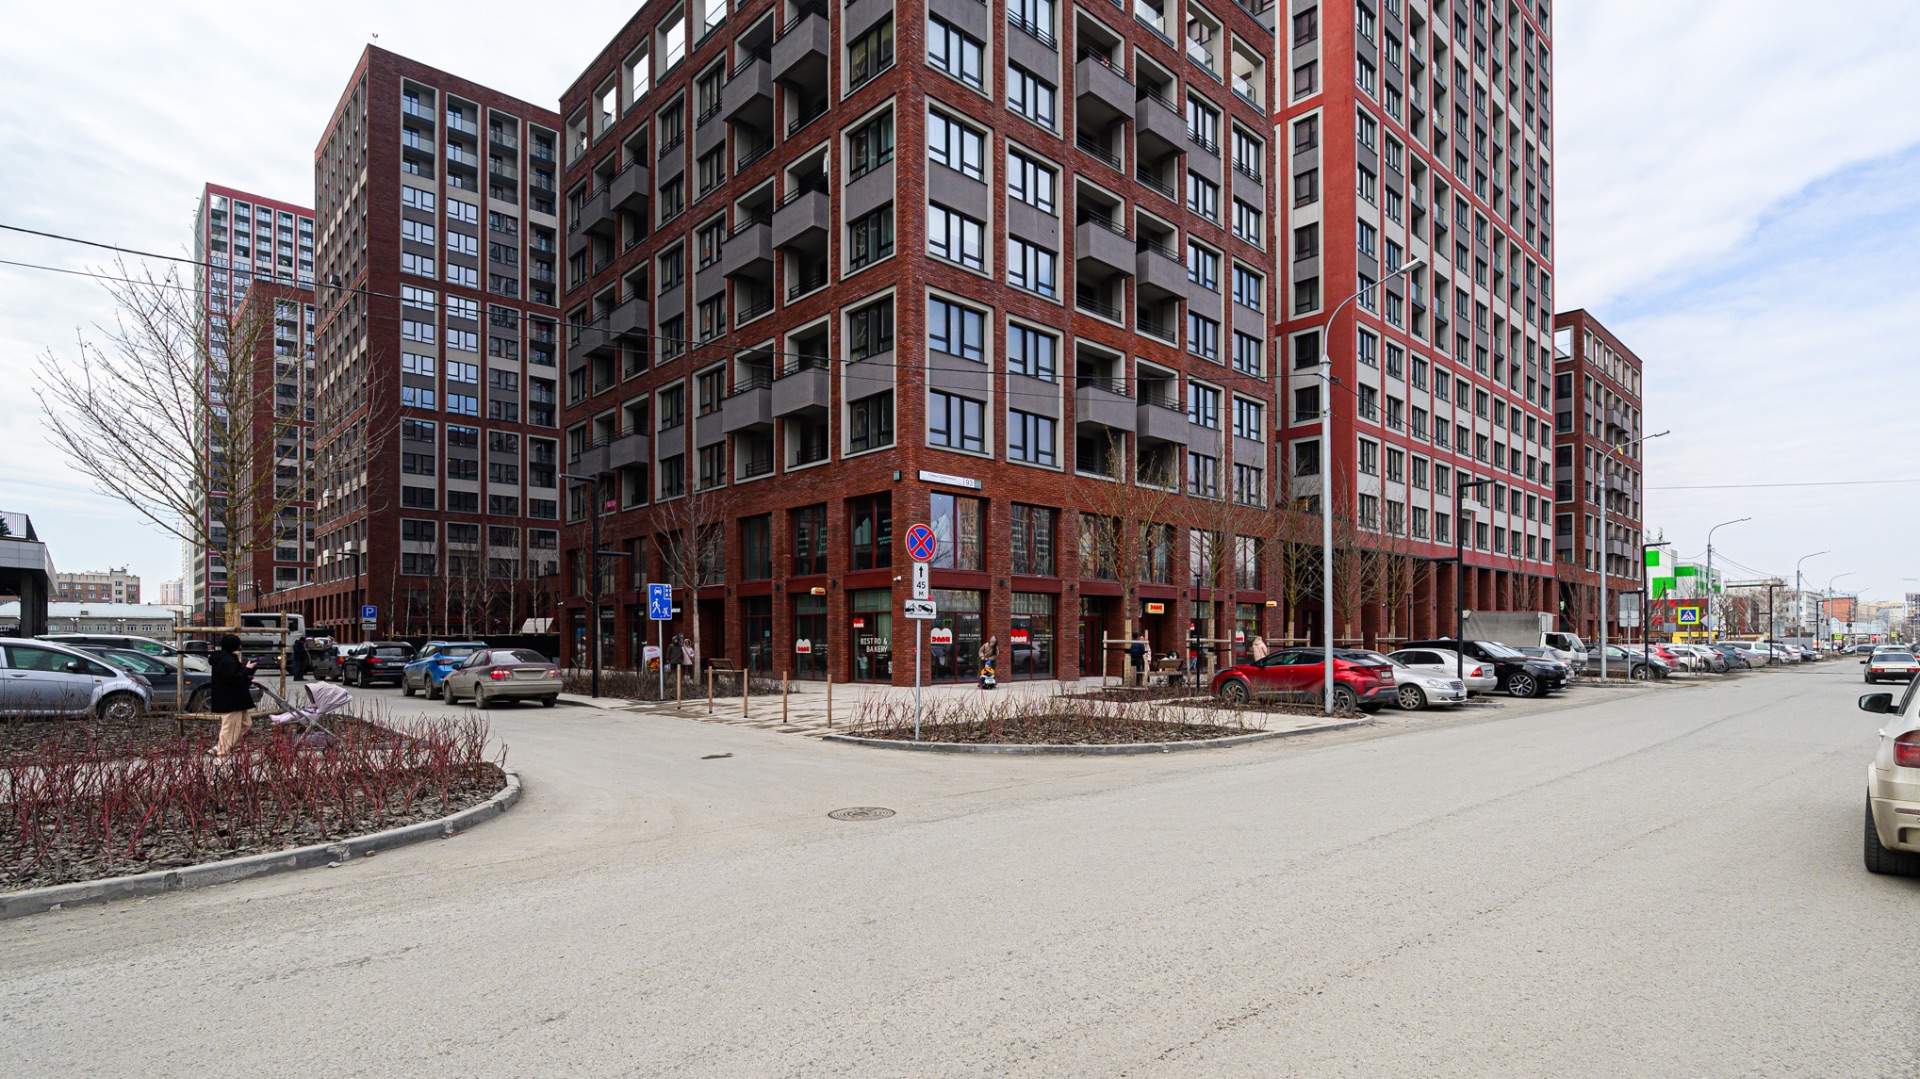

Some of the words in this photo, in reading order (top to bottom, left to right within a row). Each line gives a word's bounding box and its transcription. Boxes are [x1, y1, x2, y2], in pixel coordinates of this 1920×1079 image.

[916, 581, 926, 589] 45
[366, 607, 374, 617] P
[860, 637, 881, 646] BISTRO
[866, 645, 888, 653] BAKERY
